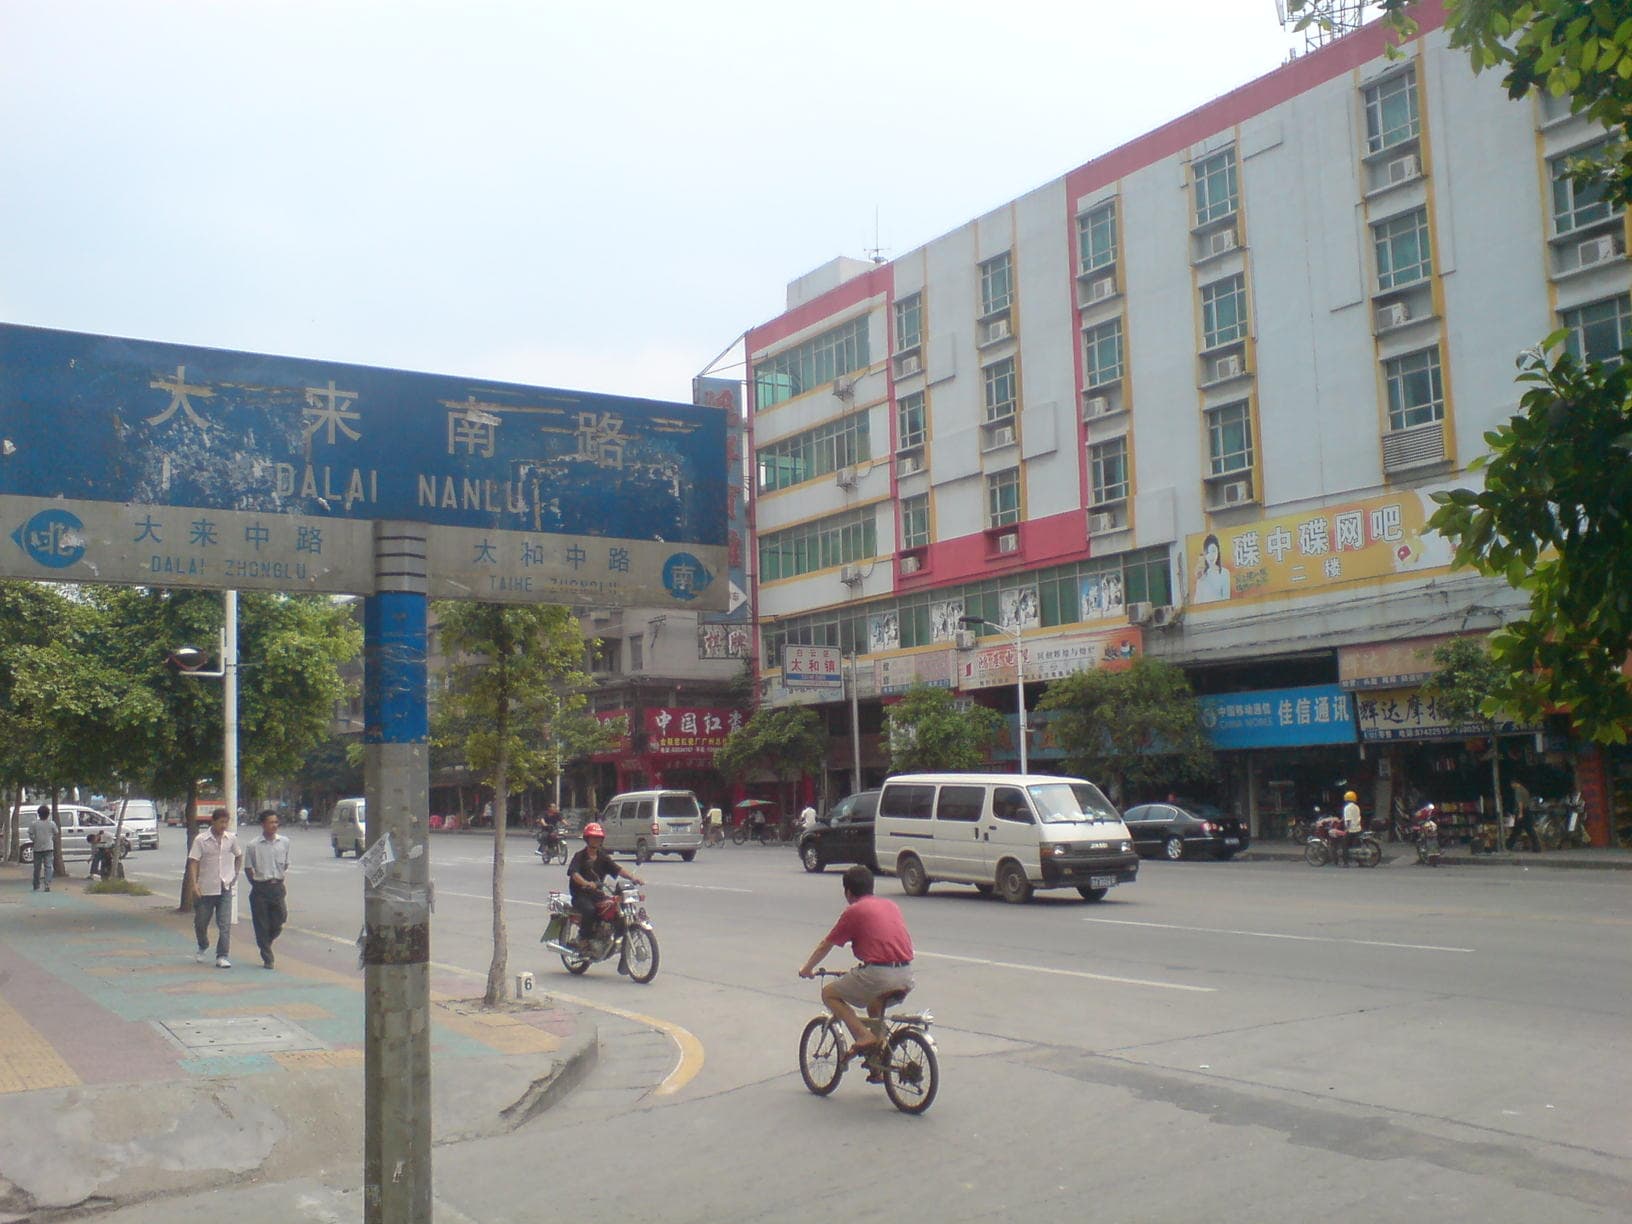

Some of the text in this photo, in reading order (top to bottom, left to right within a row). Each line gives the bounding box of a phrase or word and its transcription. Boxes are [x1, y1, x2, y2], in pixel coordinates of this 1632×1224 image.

[146, 365, 628, 470] 大来南路
[275, 463, 525, 513] DALAI NANLU
[134, 515, 323, 555] 大来中路
[1232, 504, 1402, 568] 碟中碟网吧
[151, 556, 307, 580] DALAI ZHONGLU
[473, 538, 631, 574] 太和中路
[1290, 556, 1342, 582] 二楼
[489, 575, 533, 593] TAIHE
[672, 562, 695, 592] 南
[791, 658, 837, 673] 太和镇
[1278, 695, 1350, 727] 佳信通讯
[524, 978, 532, 990] 6
